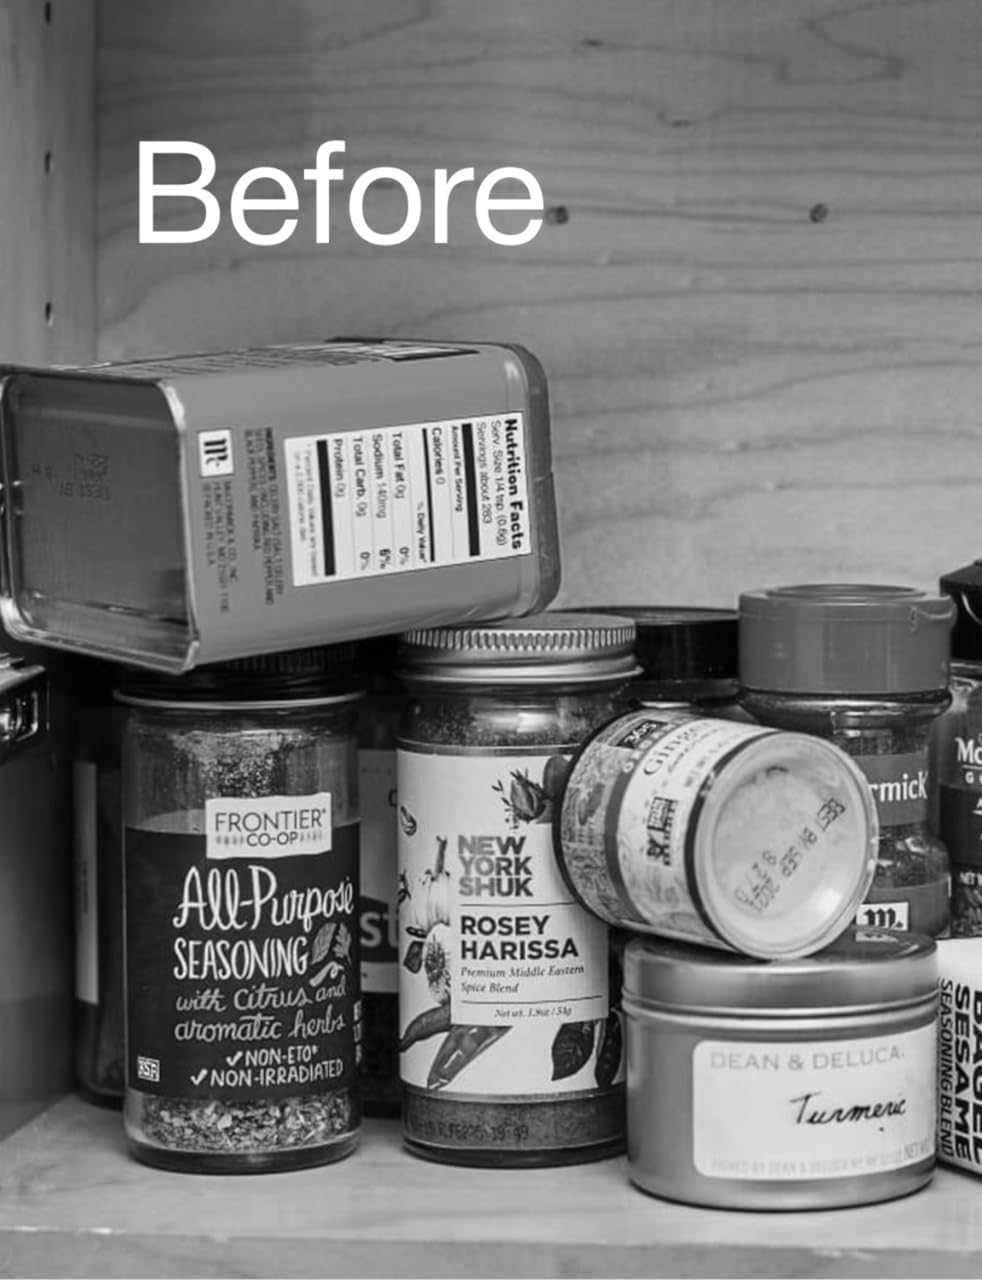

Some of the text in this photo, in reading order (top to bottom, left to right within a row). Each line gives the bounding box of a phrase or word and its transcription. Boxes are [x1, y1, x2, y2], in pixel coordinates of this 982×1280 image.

[352, 437, 365, 465] Total
[392, 433, 405, 460] Total
[431, 428, 445, 475] Calories
[450, 426, 462, 460] Amount
[475, 422, 488, 468] Servings
[333, 439, 346, 481] Protein
[393, 464, 406, 483] Fat
[492, 450, 505, 474] Size
[454, 478, 465, 513] Serving
[480, 472, 491, 502] about
[503, 419, 525, 550] Nutrition Facts
[371, 434, 385, 480] Sodium
[378, 549, 392, 569] 6%
[415, 513, 427, 534] Daily
[869, 770, 928, 802] rmick
[215, 808, 324, 832] FRONTIER
[815, 797, 846, 832] BEST
[246, 832, 298, 846] CO-OP
[458, 835, 526, 857] NEW
[458, 856, 533, 877] YORK
[780, 846, 803, 879] SEP
[173, 865, 354, 933] All-Purpose
[458, 876, 534, 898] SHUK
[460, 915, 550, 937] ROSEY
[173, 937, 309, 981] SEASONING
[460, 938, 579, 962] HARISSA
[461, 965, 585, 978] Premium Middle Eastern
[176, 988, 226, 1013] with
[315, 974, 346, 1003] and
[461, 981, 519, 995] Spice Blend
[175, 1012, 282, 1043] aromatic
[288, 1002, 346, 1039] herbs
[210, 1058, 344, 1087] NON-IRRADIATED
[710, 1051, 780, 1071] DEAN
[787, 1052, 804, 1071] &
[940, 977, 955, 1159] SEASONING BLEND
[954, 981, 972, 1163] SESAME
[790, 1090, 907, 1125] Turmeric
